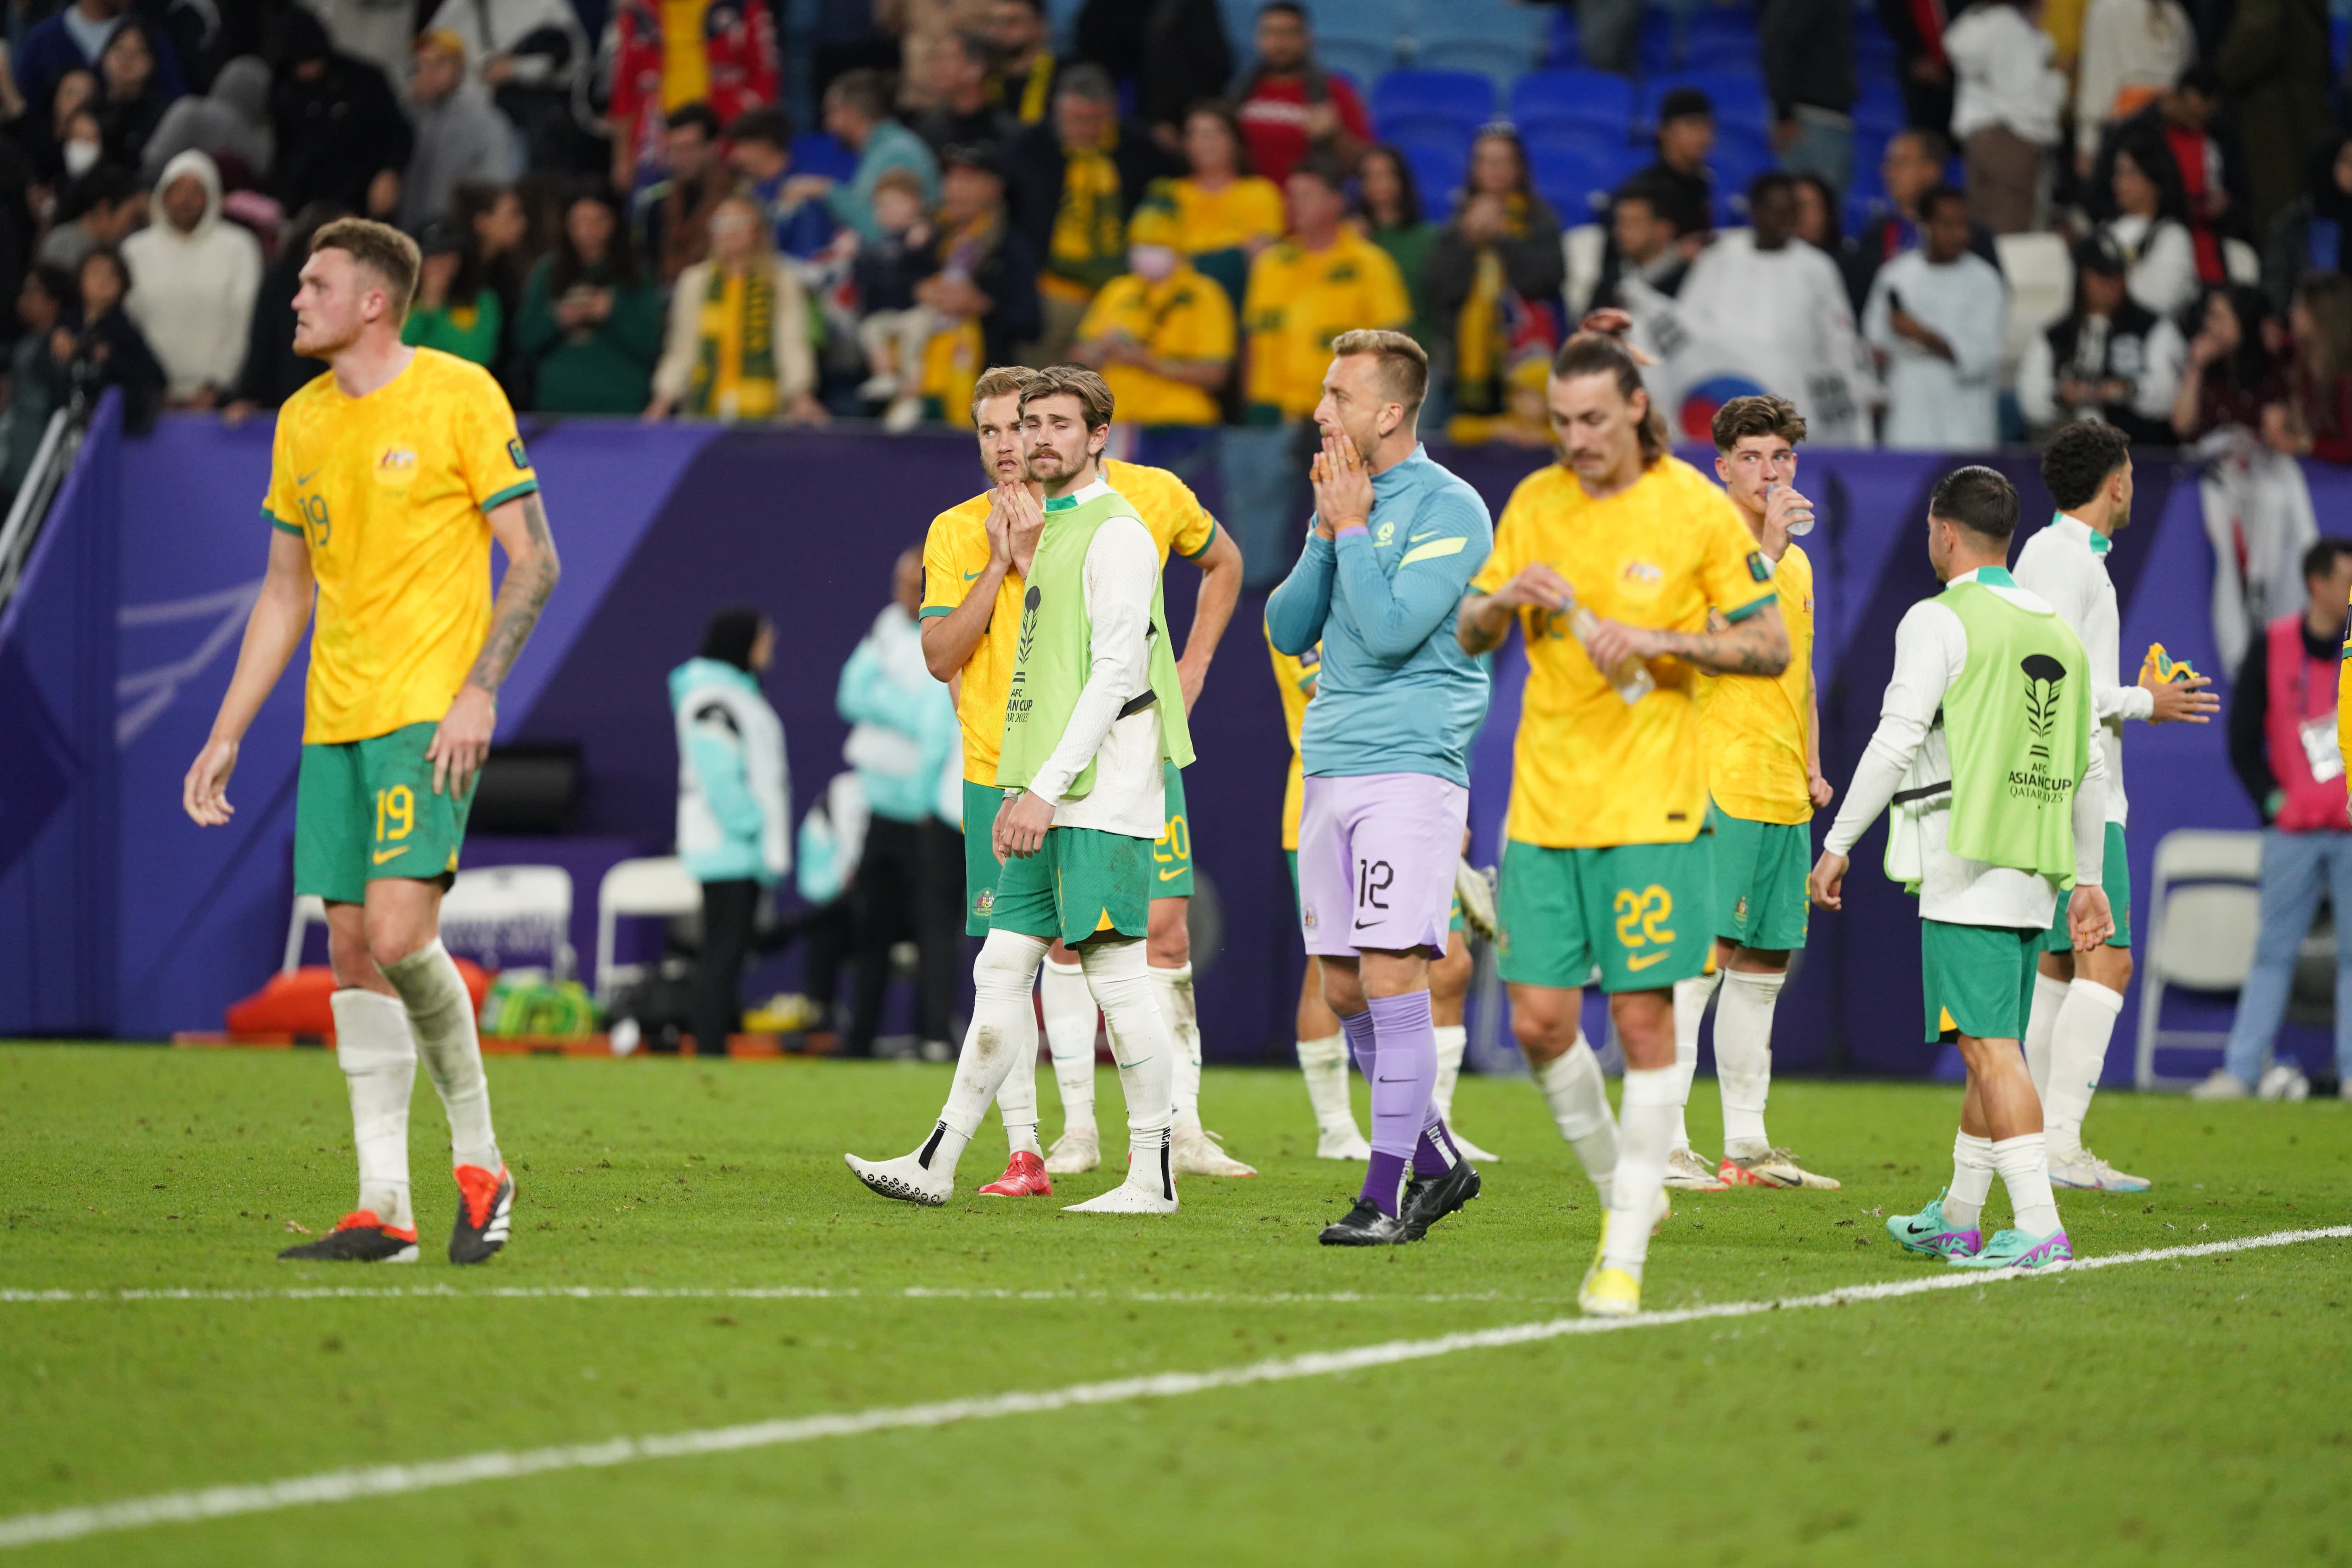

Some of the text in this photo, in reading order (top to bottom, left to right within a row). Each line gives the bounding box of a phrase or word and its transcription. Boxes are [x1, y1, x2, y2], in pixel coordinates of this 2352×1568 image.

[300, 494, 331, 547] 19
[1011, 689, 1023, 697] AFC
[1020, 699, 1033, 711] CUP
[2009, 770, 2072, 791] ASIAN CUP
[2032, 763, 2047, 774] AFC
[2010, 786, 2042, 800] QATAR
[376, 784, 414, 842] 19
[1153, 815, 1190, 862] 20
[1360, 859, 1393, 909] 12
[1614, 883, 1676, 948] 22
